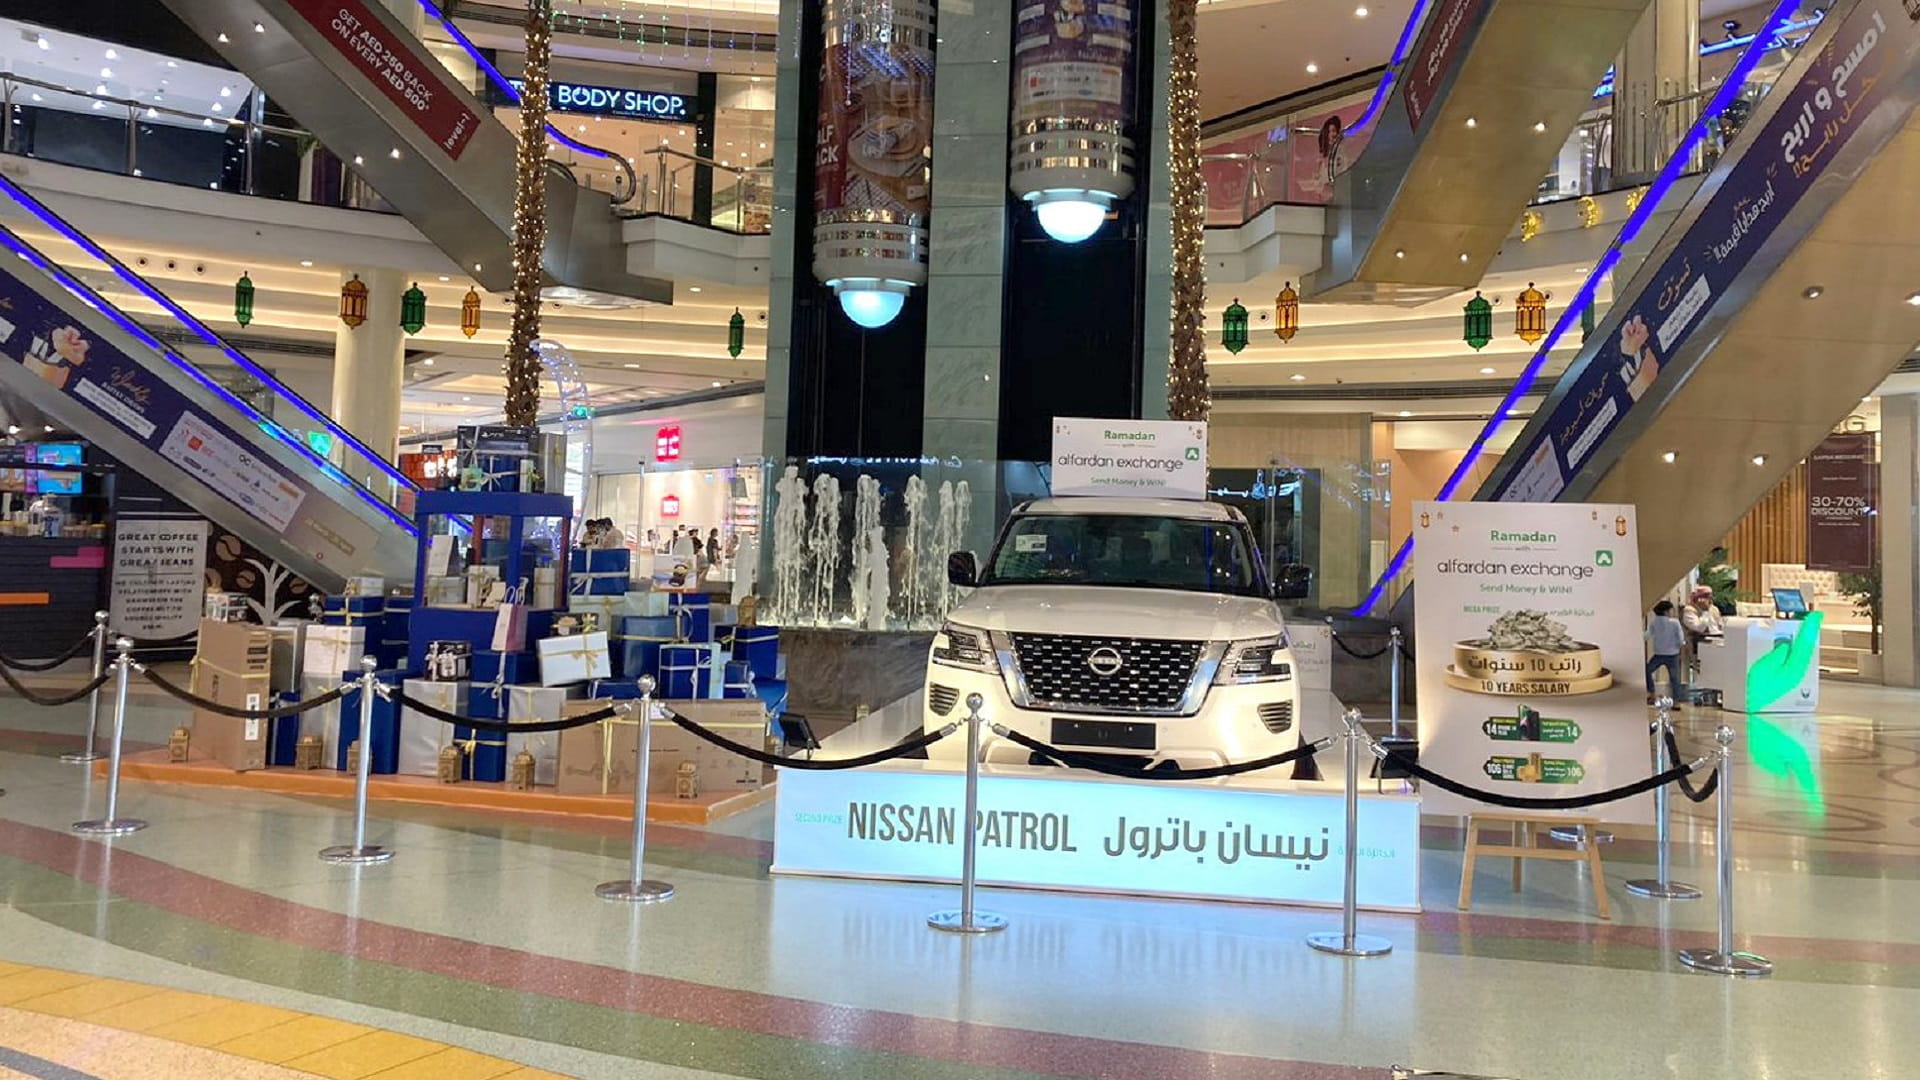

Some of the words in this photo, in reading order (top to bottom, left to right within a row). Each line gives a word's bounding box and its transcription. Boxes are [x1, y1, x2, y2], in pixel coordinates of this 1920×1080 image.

[331, 18, 350, 39] ON
[349, 36, 383, 68] EVERY
[381, 69, 405, 91] AED
[339, 8, 361, 31] GET
[360, 31, 383, 53] AED
[381, 50, 404, 73] 250
[403, 70, 434, 101] BACK
[558, 85, 620, 108] BODY
[1815, 87, 1832, 110] و
[1104, 430, 1156, 441] Ramadan
[1058, 453, 1113, 468] alfardan
[1117, 457, 1183, 472] exchange
[1811, 496, 1867, 507] 30-70%
[1811, 507, 1866, 516] DISCOUNT
[1490, 530, 1557, 543] Ramadan
[122, 546, 163, 554] STARTS
[1437, 559, 1507, 574] alfardan
[1510, 562, 1594, 580] exchange
[1479, 583, 1503, 593] Send
[1505, 584, 1537, 596] Money
[1539, 585, 1545, 594] &
[1549, 585, 1573, 594] WIN!
[1468, 655, 1525, 673] سنوات
[1531, 658, 1546, 672] 10
[1549, 658, 1581, 675] راتب
[1481, 681, 1494, 692] 10
[1495, 681, 1530, 693] YEARS
[1530, 682, 1571, 694] SALARY
[1486, 724, 1497, 735] 14
[1567, 726, 1578, 737] 14
[847, 802, 956, 845] NISSAN
[1104, 816, 1206, 864] باترول
[1218, 821, 1329, 871] نيسان
